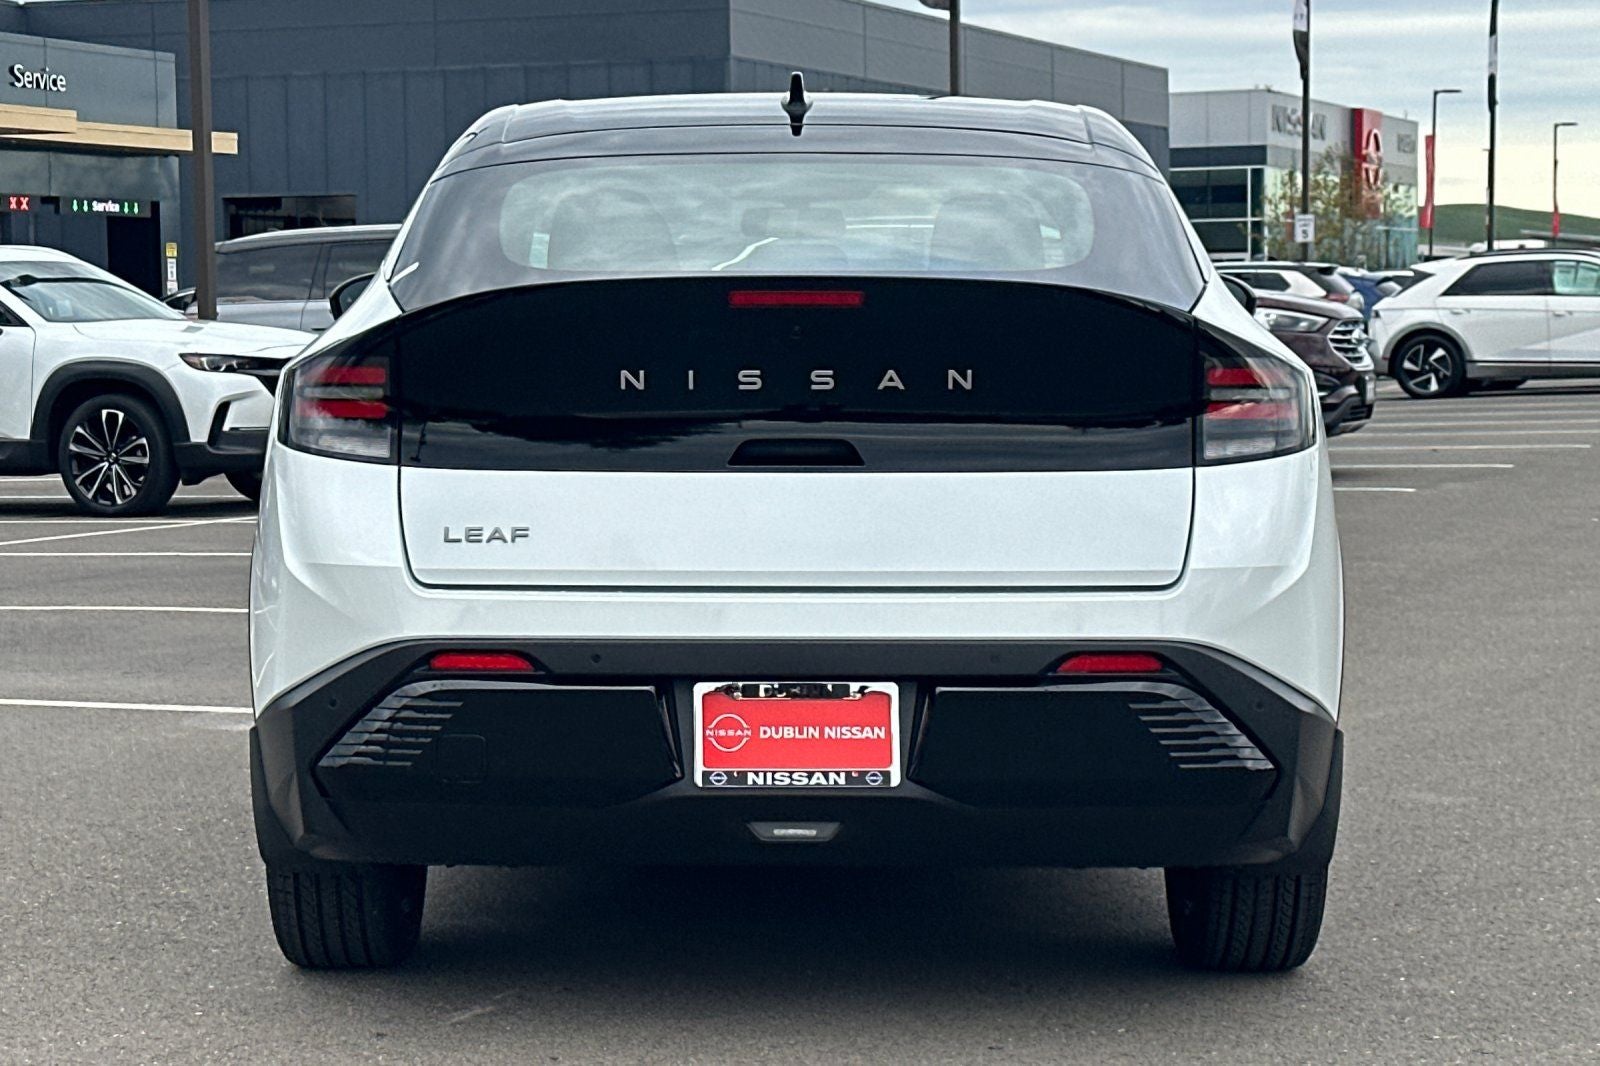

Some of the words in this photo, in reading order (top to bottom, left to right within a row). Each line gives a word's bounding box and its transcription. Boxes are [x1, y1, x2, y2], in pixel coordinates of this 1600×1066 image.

[13, 63, 67, 92] Service
[91, 199, 120, 212] Service
[619, 369, 973, 390] NISSAN
[443, 526, 530, 543] LEAF
[705, 729, 752, 737] NISSAN
[759, 726, 820, 739] DUBLIN
[824, 726, 886, 739] NISSAN
[747, 771, 847, 786] NISSAN
